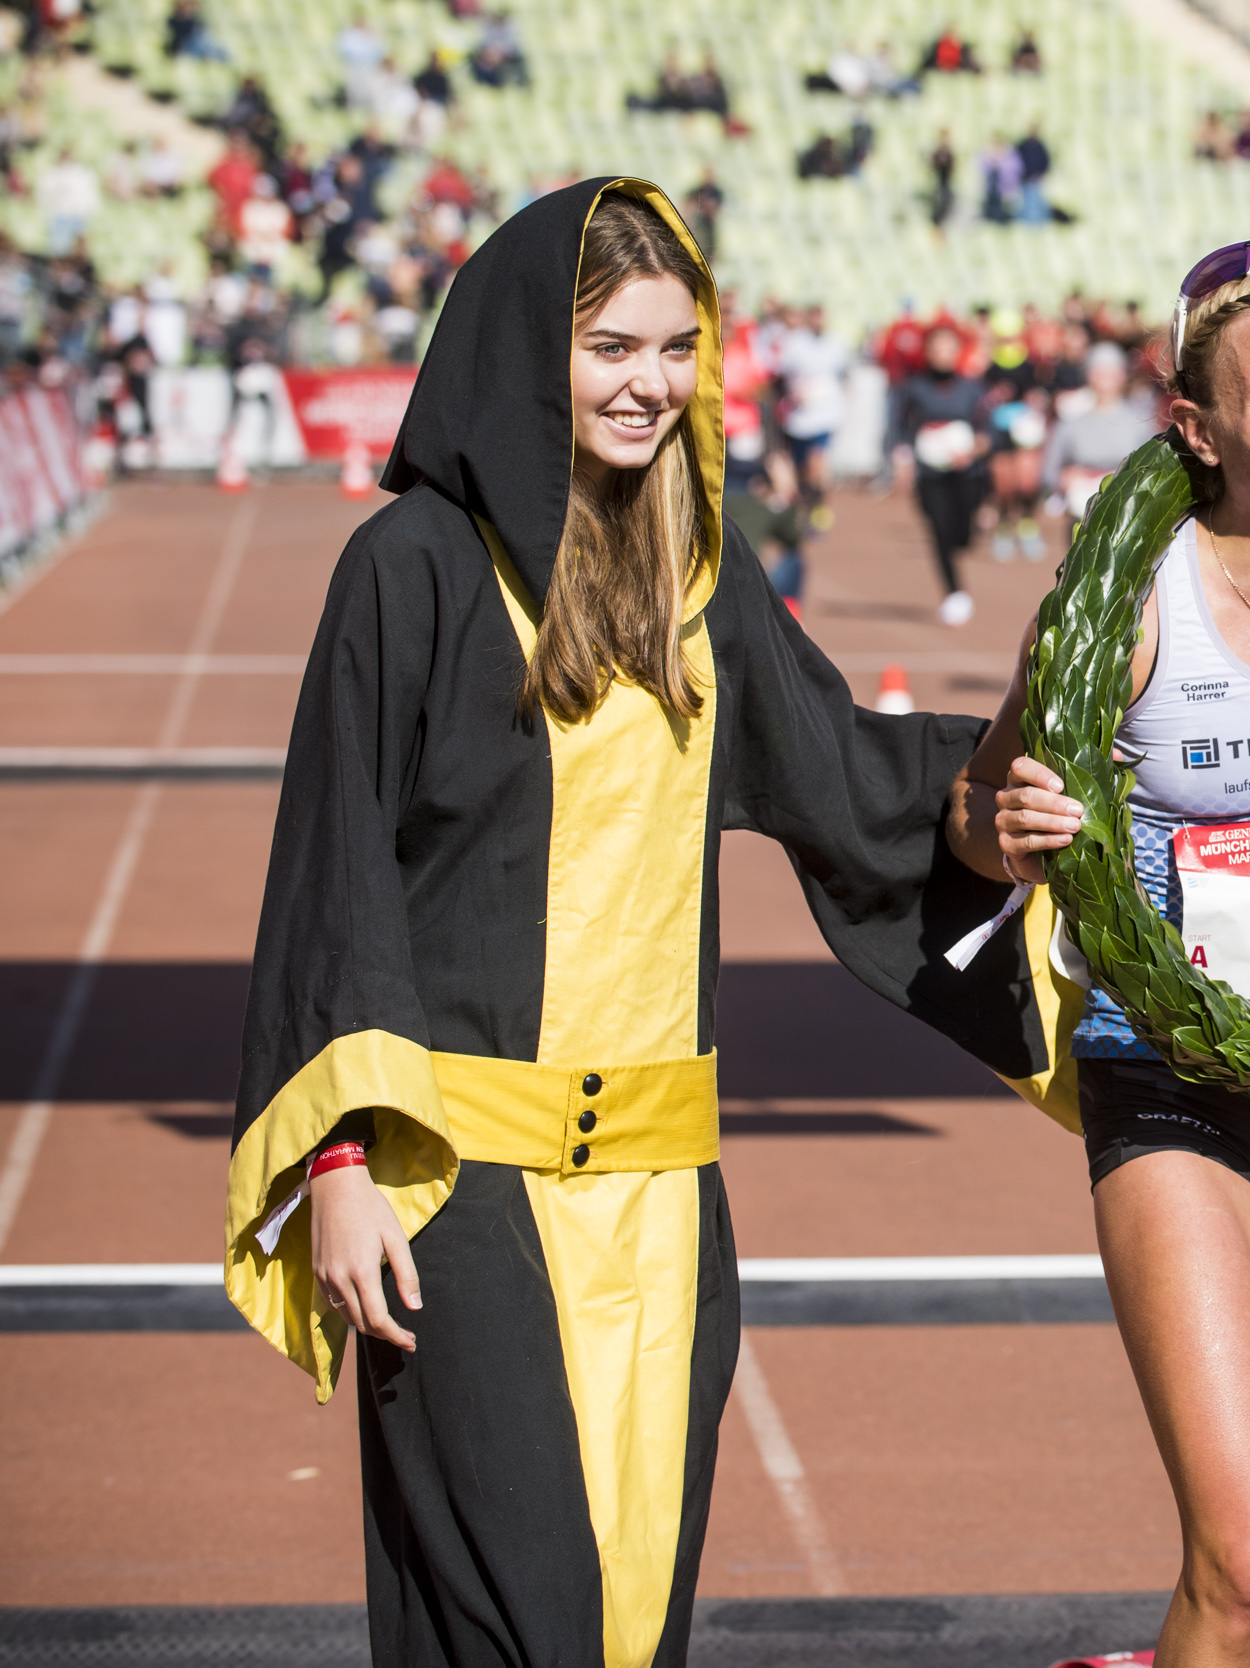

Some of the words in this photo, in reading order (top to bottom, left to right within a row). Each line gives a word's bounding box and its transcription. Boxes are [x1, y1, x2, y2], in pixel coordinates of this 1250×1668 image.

[1181, 681, 1229, 693] Corinna
[1187, 690, 1226, 701] Harrer
[1188, 934, 1212, 942] START
[1190, 945, 1208, 968] A
[320, 1146, 355, 1161] MARATHON
